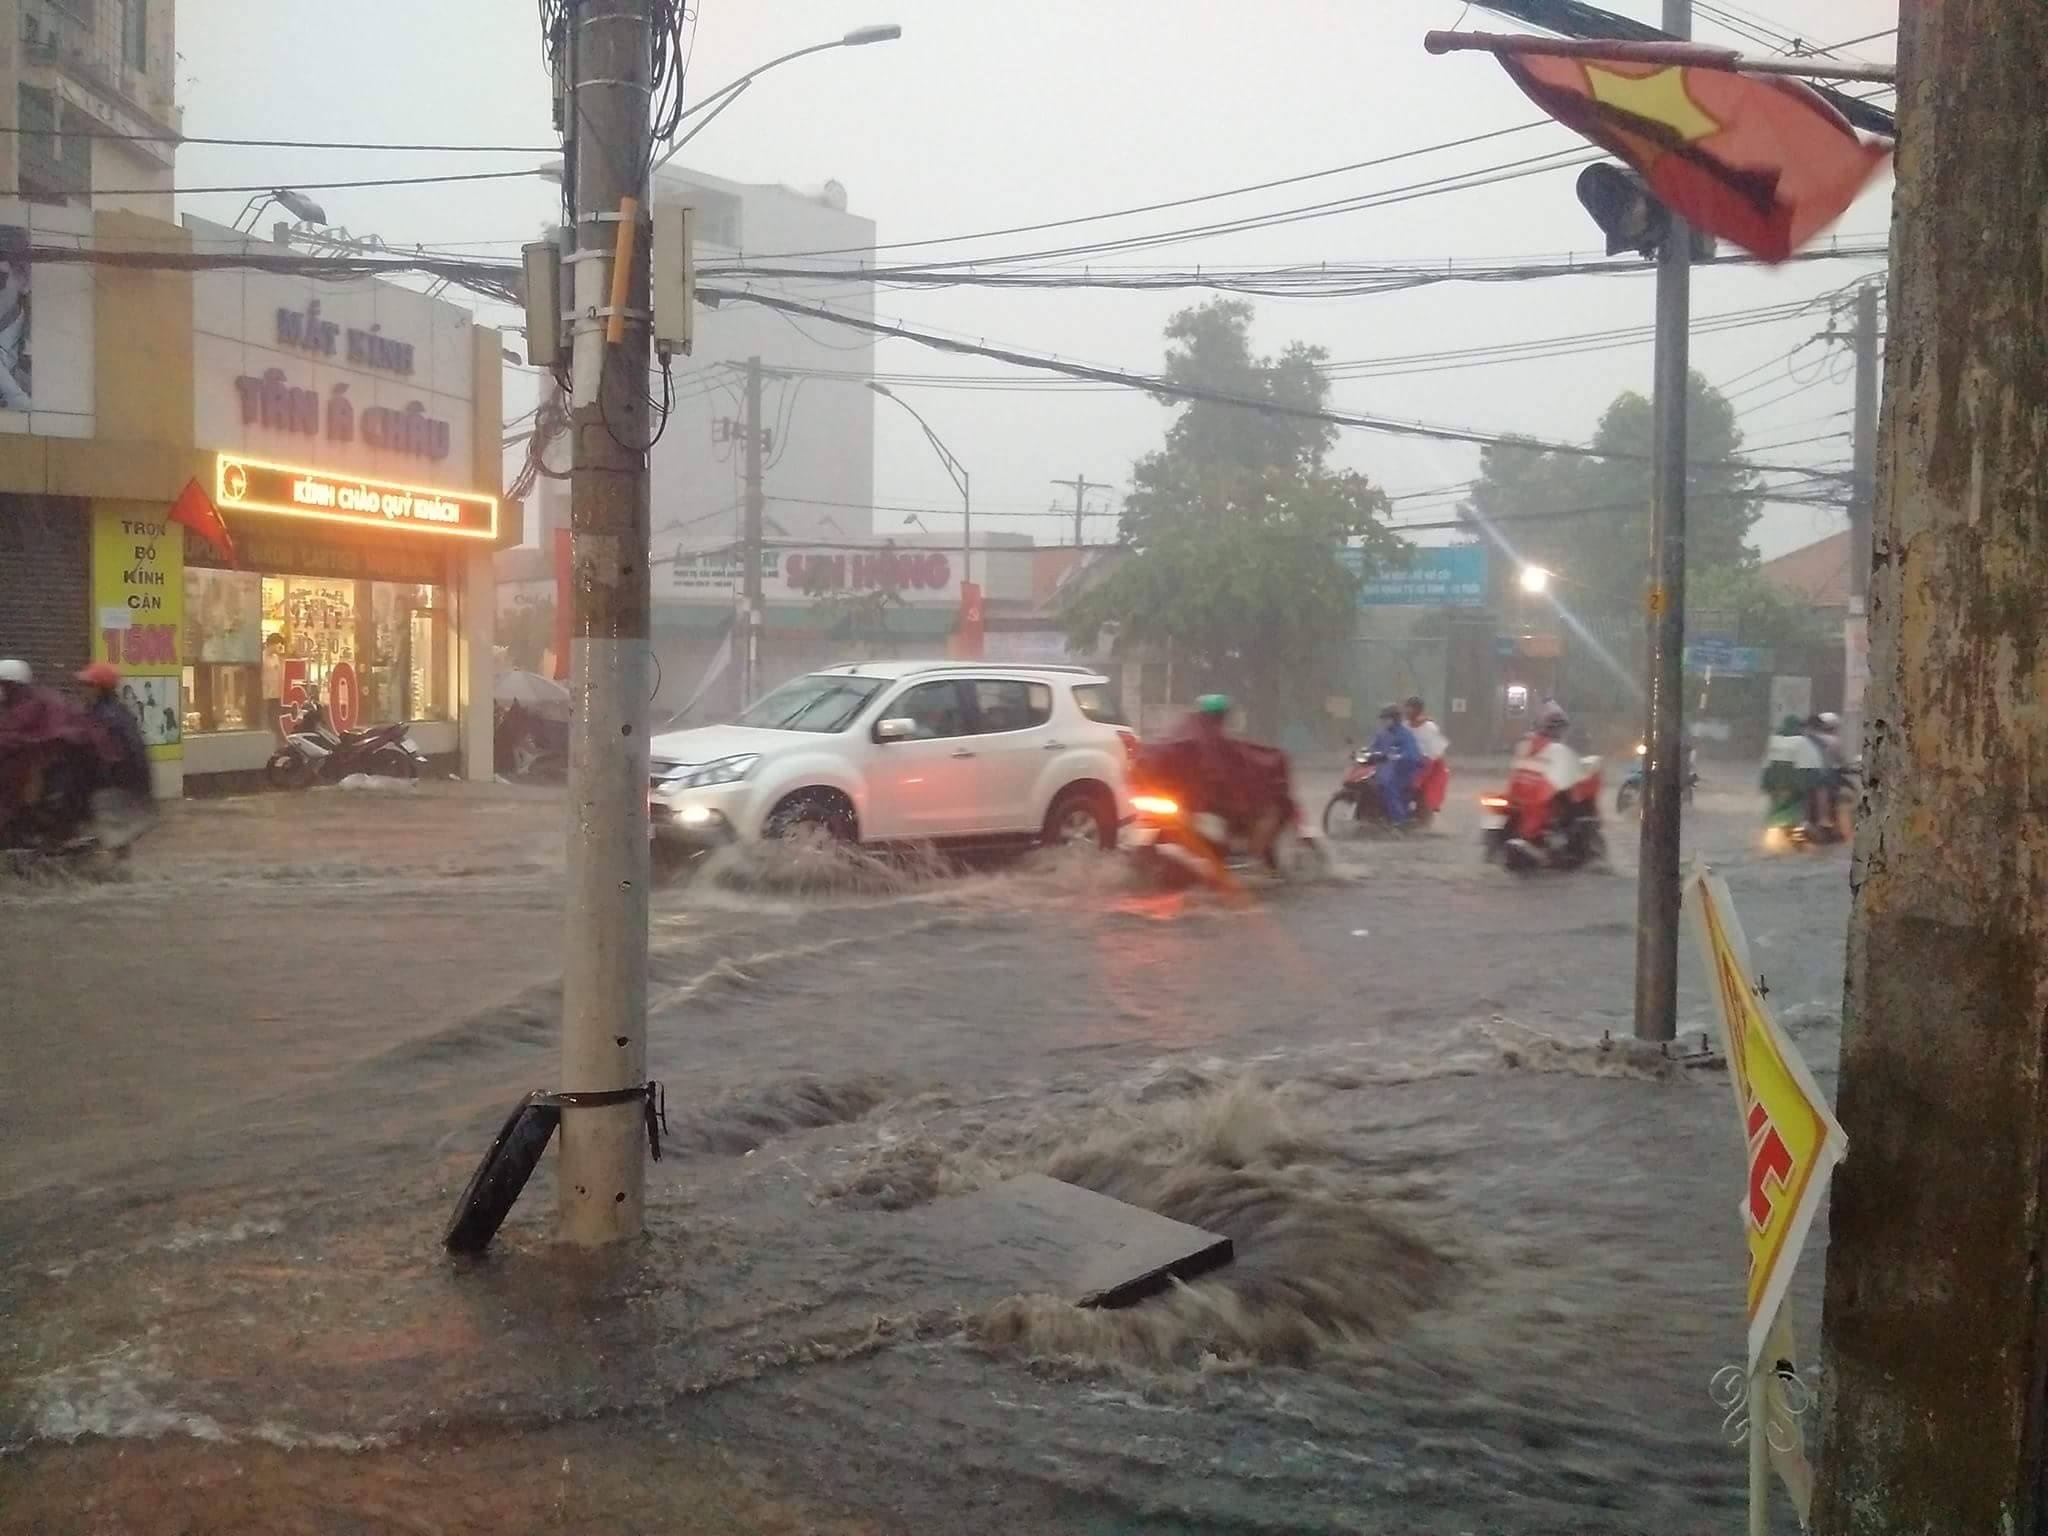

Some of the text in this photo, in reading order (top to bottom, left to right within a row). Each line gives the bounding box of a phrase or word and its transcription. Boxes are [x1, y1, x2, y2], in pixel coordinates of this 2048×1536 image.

[347, 323, 415, 376] KÍNH
[234, 367, 449, 461] TÂN Á CHÂU
[293, 476, 459, 523] KÍNH CHÀO QUÝ KHÁCH
[135, 546, 156, 564] BỘ
[124, 567, 164, 585] KÍNH
[127, 592, 161, 613] CẬN
